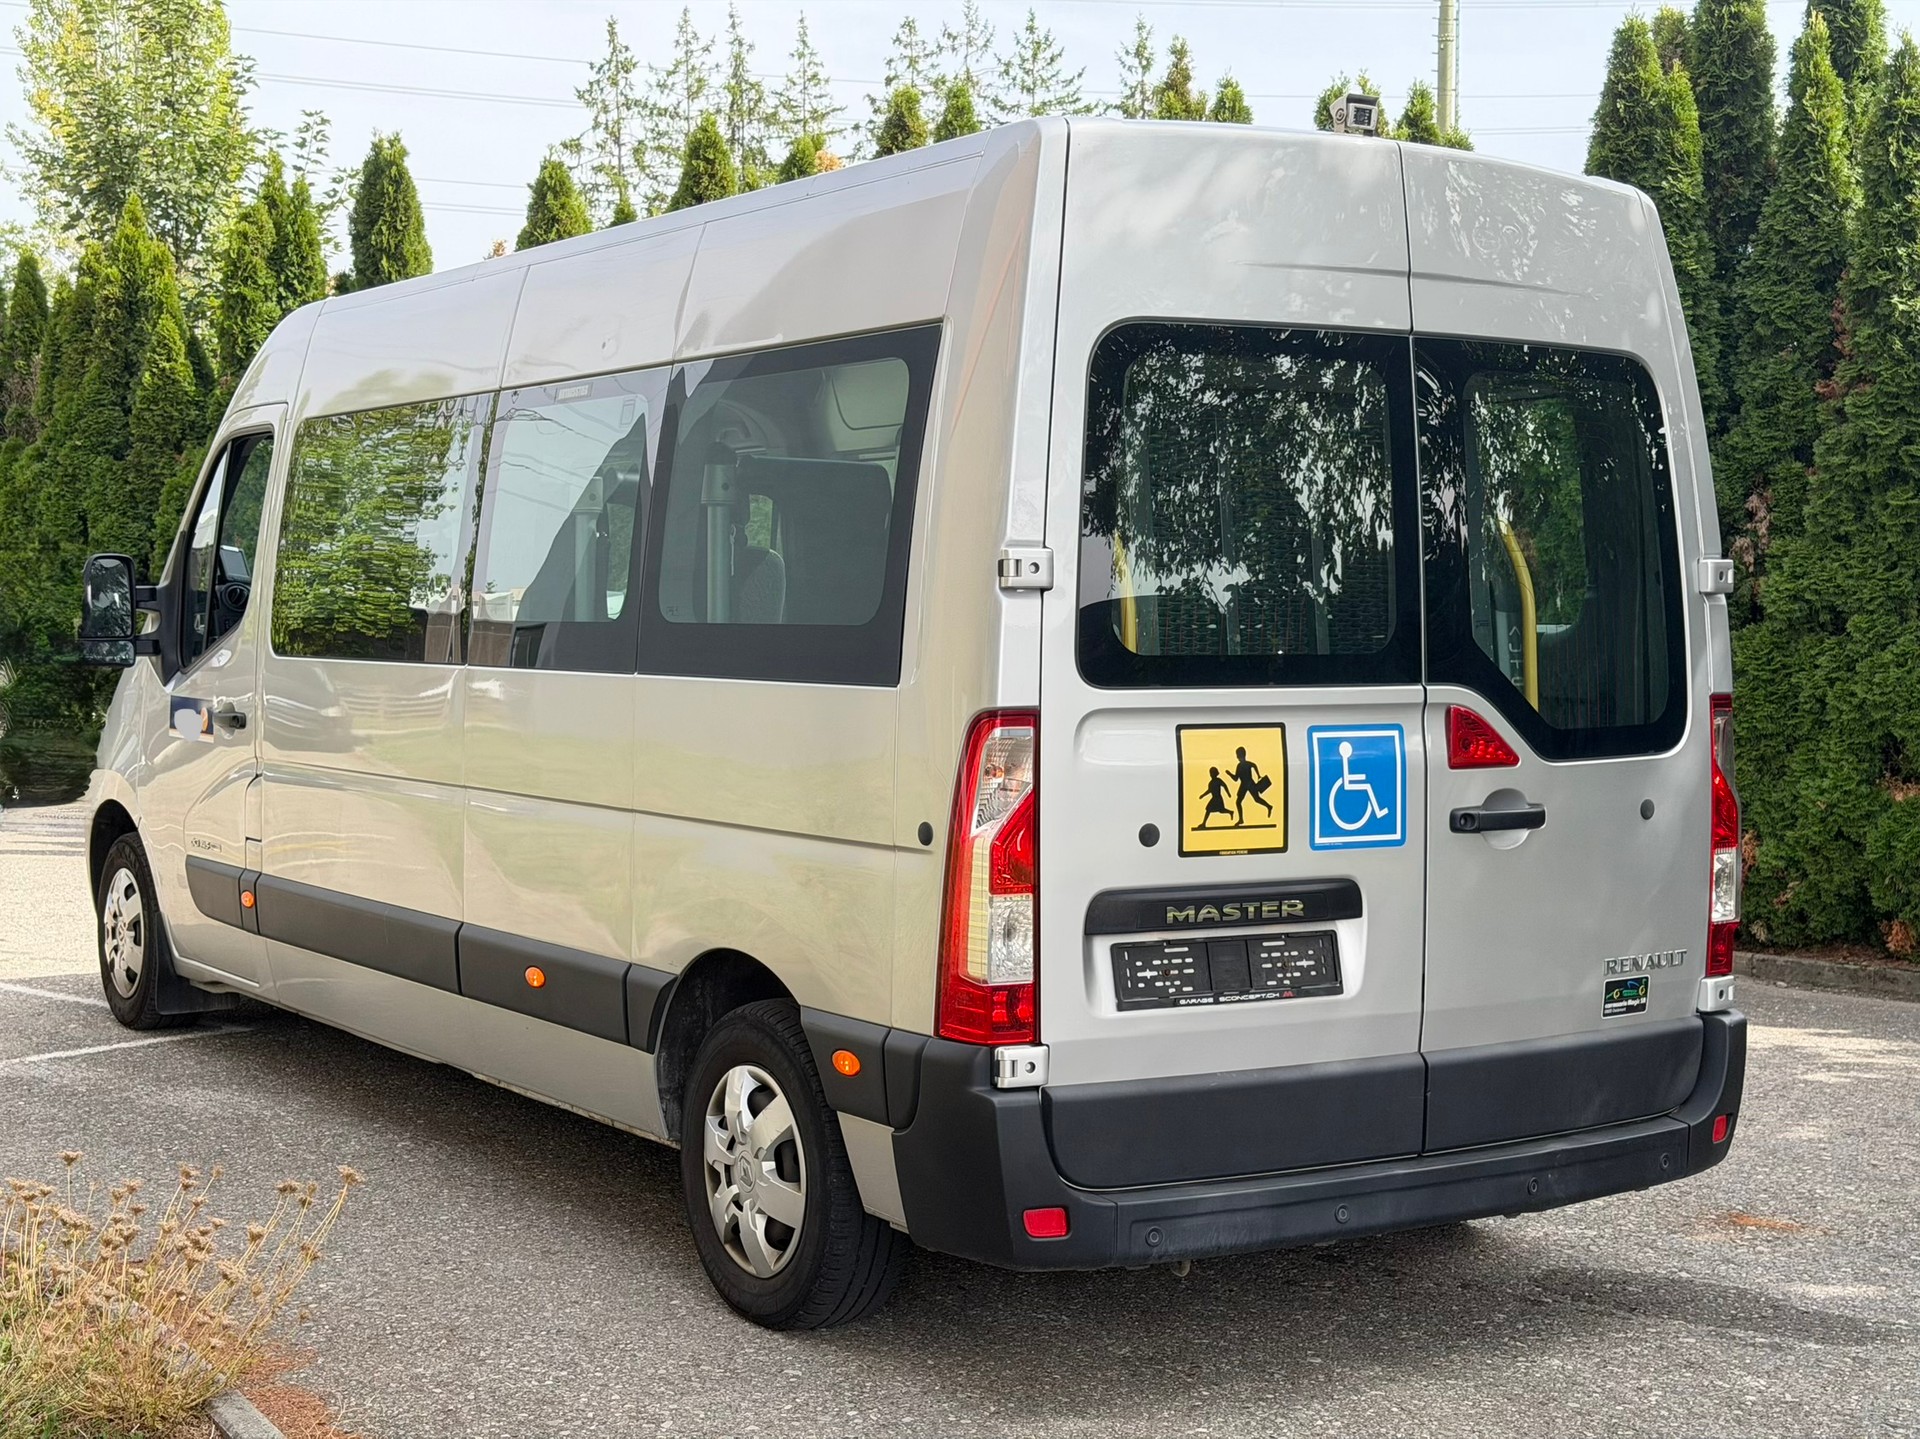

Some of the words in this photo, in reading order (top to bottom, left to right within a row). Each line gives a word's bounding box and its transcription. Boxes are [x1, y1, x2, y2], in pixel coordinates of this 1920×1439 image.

[1166, 899, 1305, 924] MASTER
[1603, 949, 1688, 976] RENAULT
[1179, 997, 1214, 1005] GARAGE
